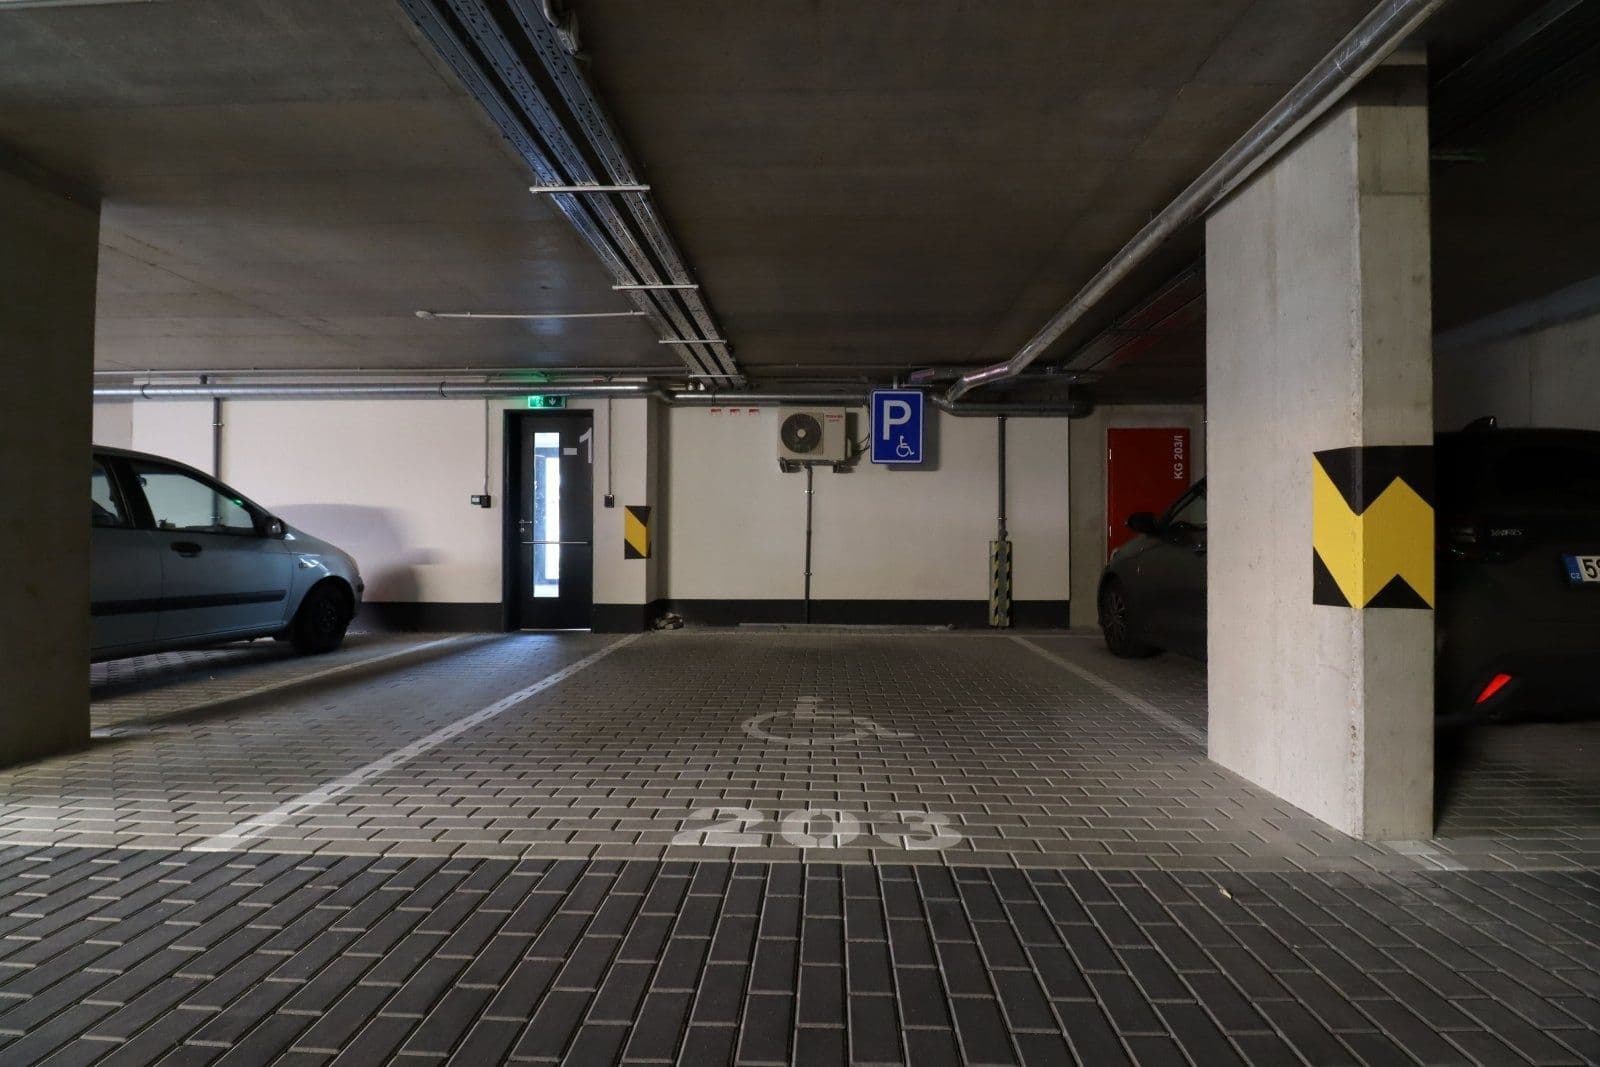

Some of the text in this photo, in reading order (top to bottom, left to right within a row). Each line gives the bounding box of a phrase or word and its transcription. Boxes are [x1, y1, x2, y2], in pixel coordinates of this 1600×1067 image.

[883, 400, 912, 440] P
[1173, 463, 1184, 479] KG
[672, 807, 963, 850] 203
